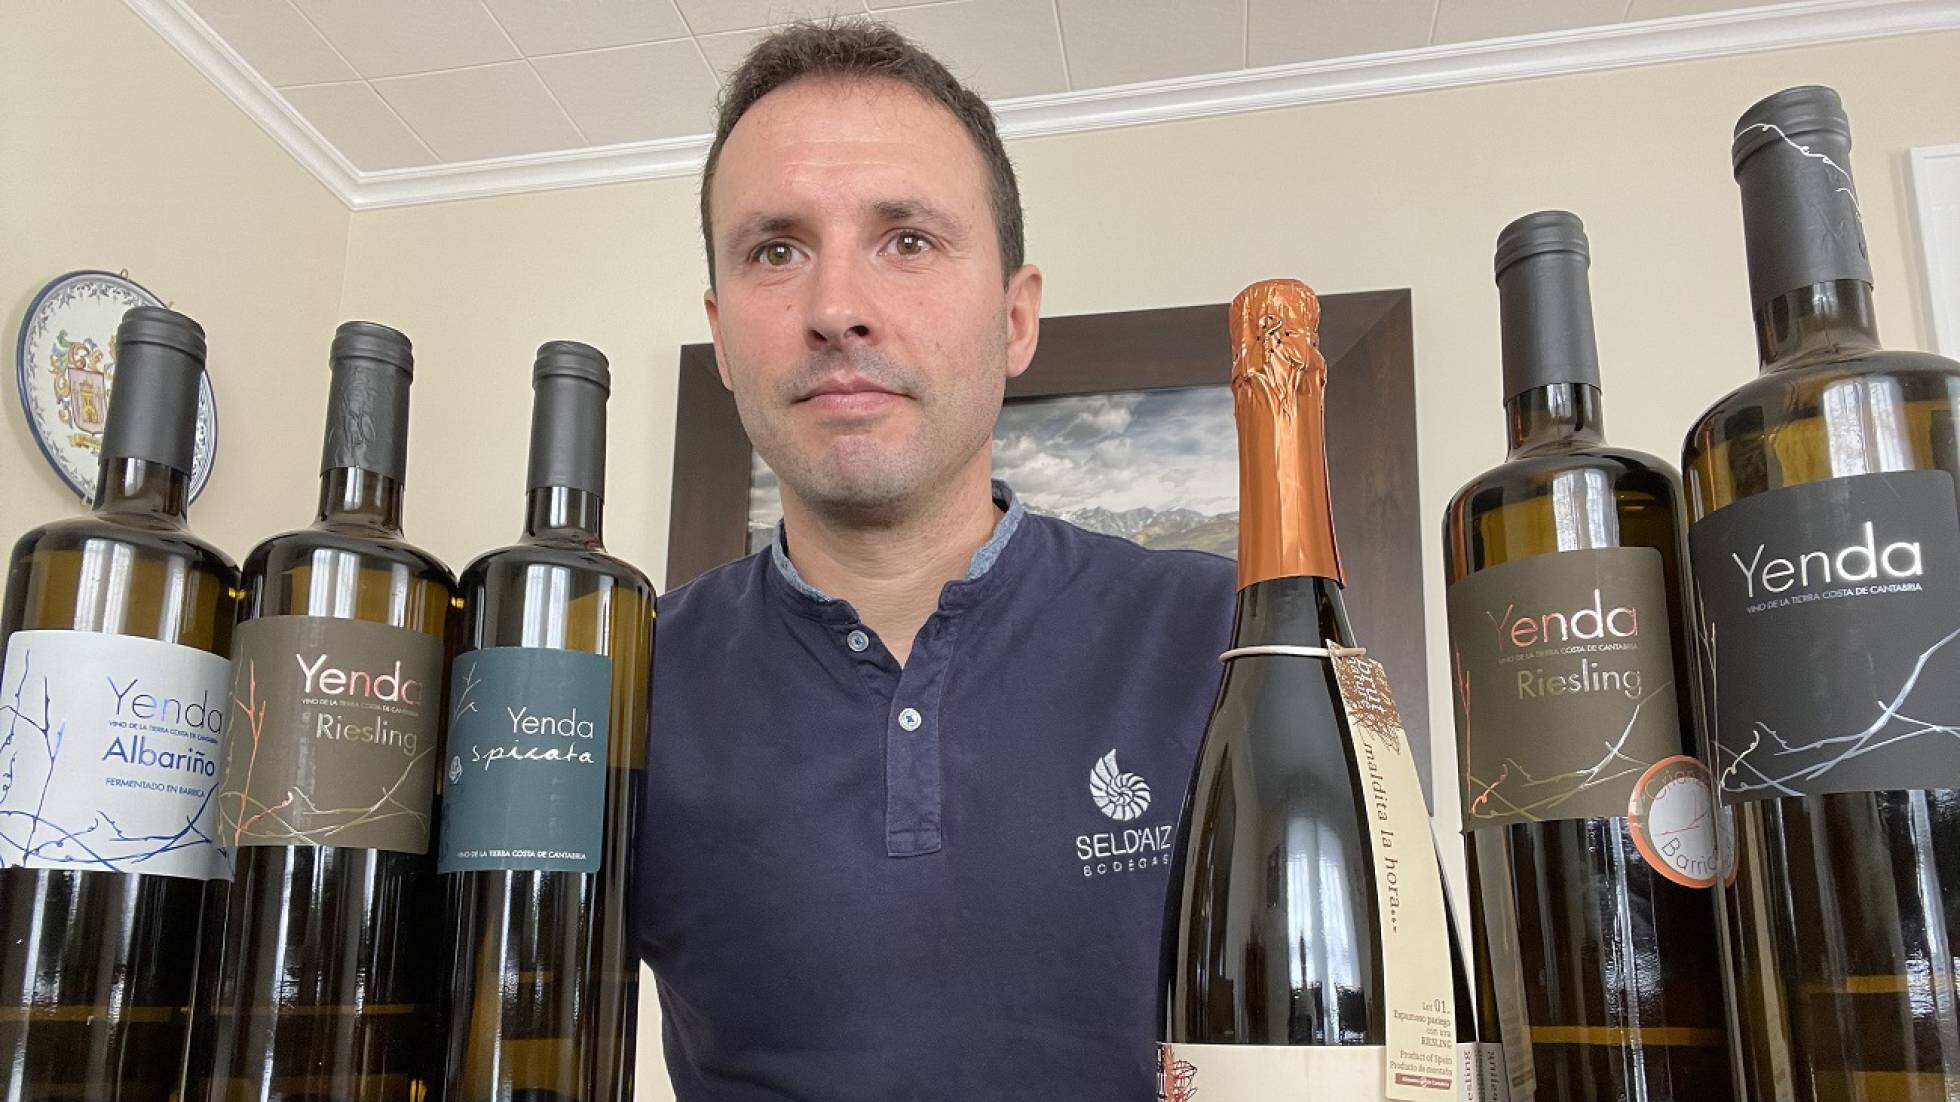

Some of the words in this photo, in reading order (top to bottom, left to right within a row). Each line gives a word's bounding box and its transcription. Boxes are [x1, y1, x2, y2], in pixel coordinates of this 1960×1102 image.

[1732, 521, 1923, 598] Yenda
[1767, 601, 1778, 610] DE
[1780, 598, 1790, 607] LA
[1791, 593, 1820, 604] TIERRA
[1822, 588, 1854, 599] COSTA
[1856, 587, 1868, 596] DE
[1870, 582, 1923, 594] CANTABRIA
[1486, 588, 1639, 648] Yenda
[296, 653, 422, 705] Yenda
[1516, 658, 1641, 700] Riesling
[107, 676, 223, 735] Yenda
[508, 706, 594, 738] Yenda
[102, 735, 215, 777] Albariño
[316, 712, 417, 757] Riesling
[471, 739, 594, 771] spicata
[106, 777, 165, 792] FERMENTADO
[166, 783, 178, 793] EN
[1365, 743, 1388, 821] maldita
[1380, 827, 1394, 850] la
